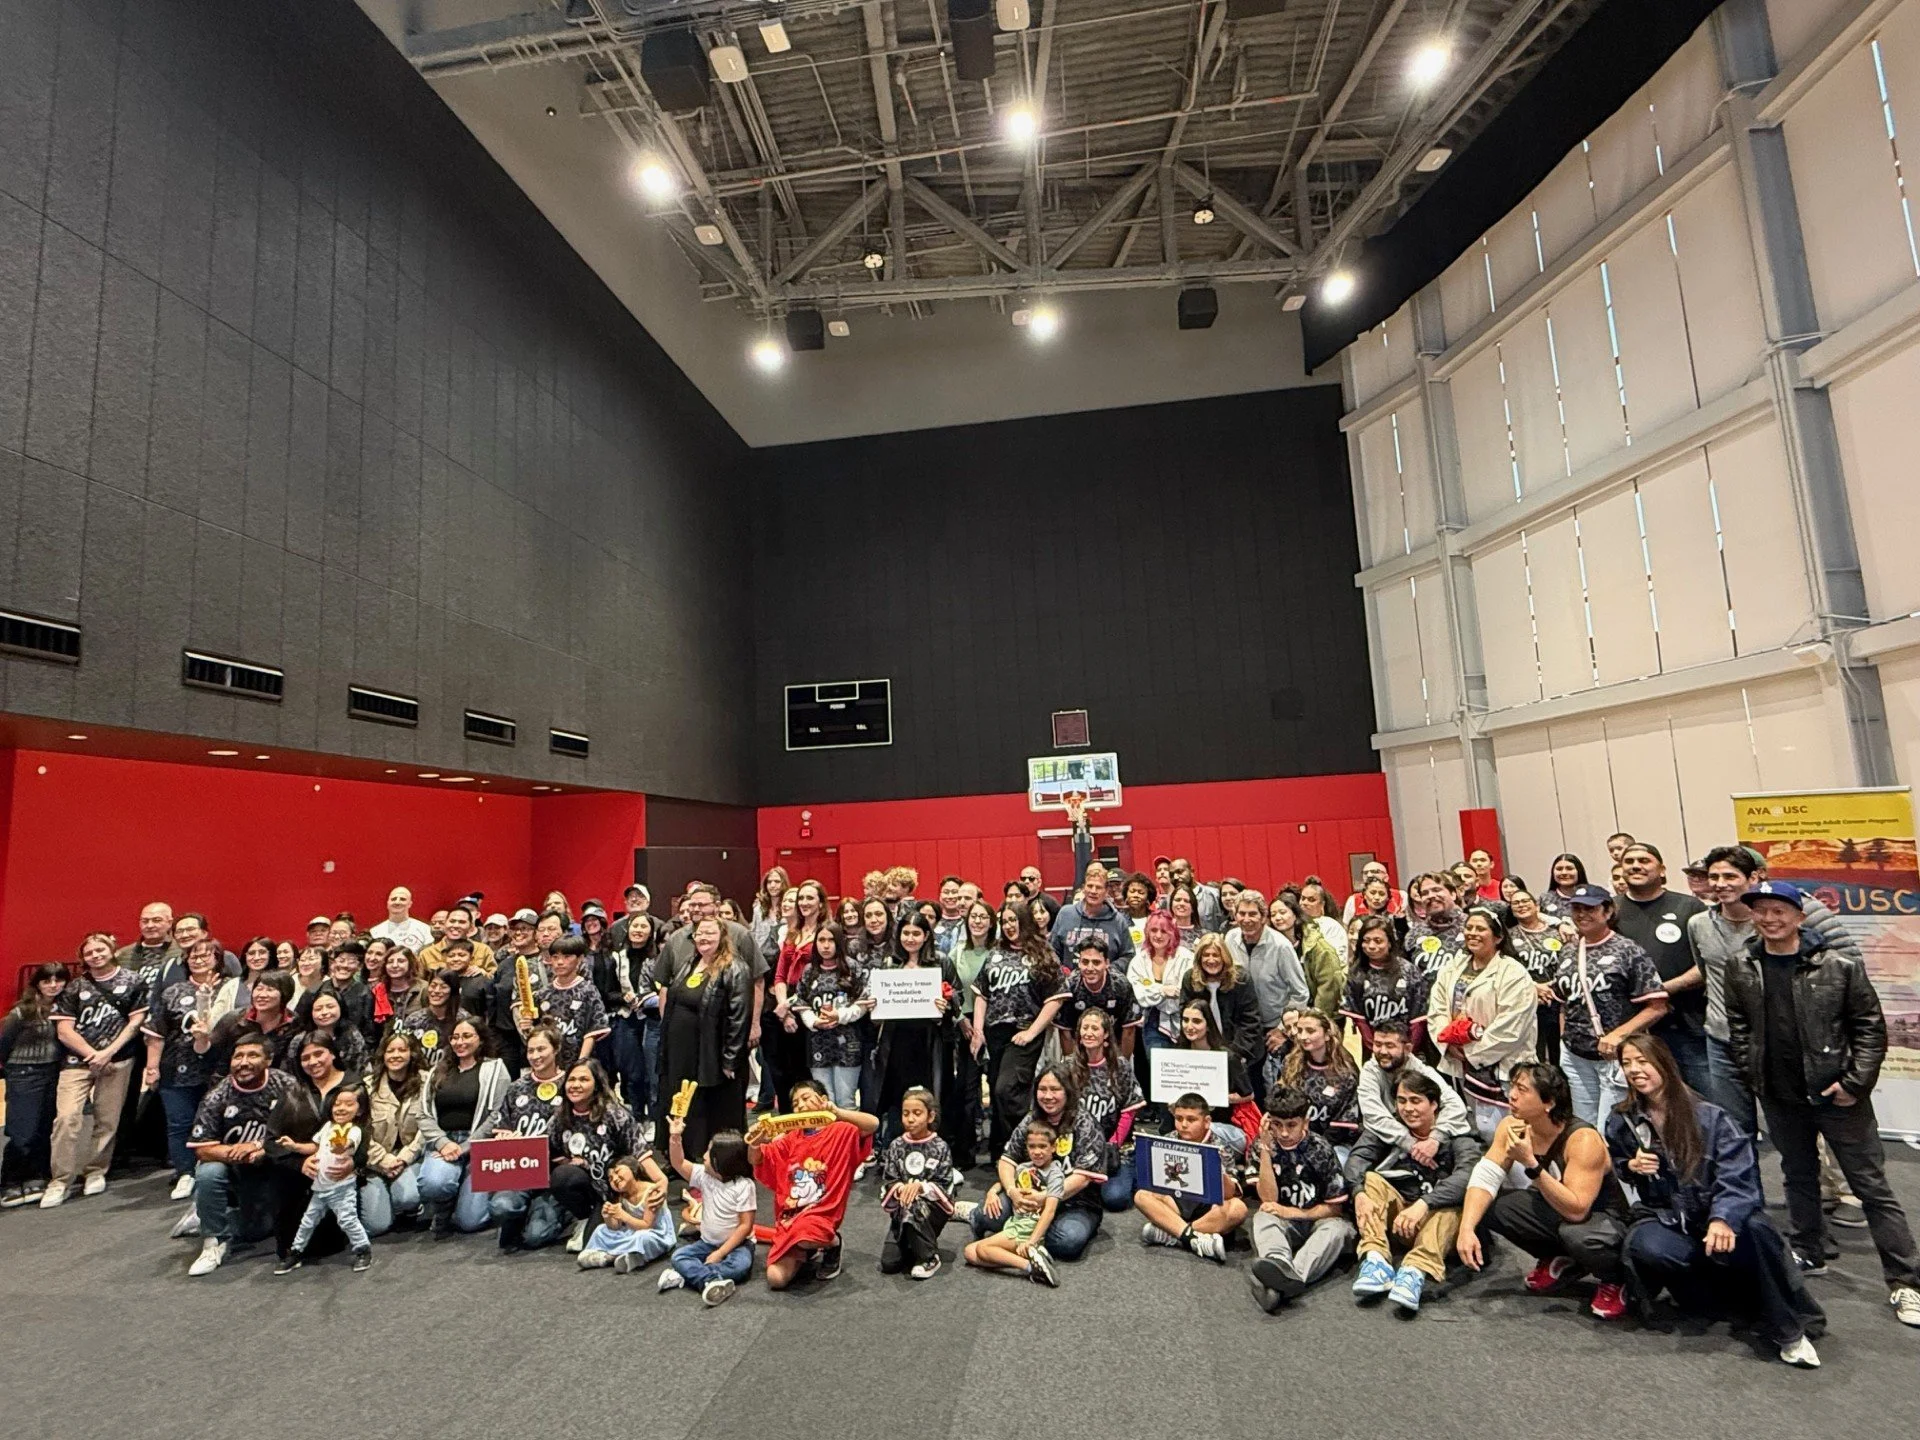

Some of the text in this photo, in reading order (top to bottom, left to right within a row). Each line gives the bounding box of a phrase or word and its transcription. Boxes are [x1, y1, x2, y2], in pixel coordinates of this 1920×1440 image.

[1519, 950, 1559, 975] Clips
[988, 966, 1031, 994] Clips
[1364, 995, 1409, 1026] Clips
[222, 1120, 267, 1145] Clip
[775, 1117, 807, 1129] FIGHT
[481, 1156, 540, 1173] Fight On
[1164, 1153, 1188, 1163] CHUCK
